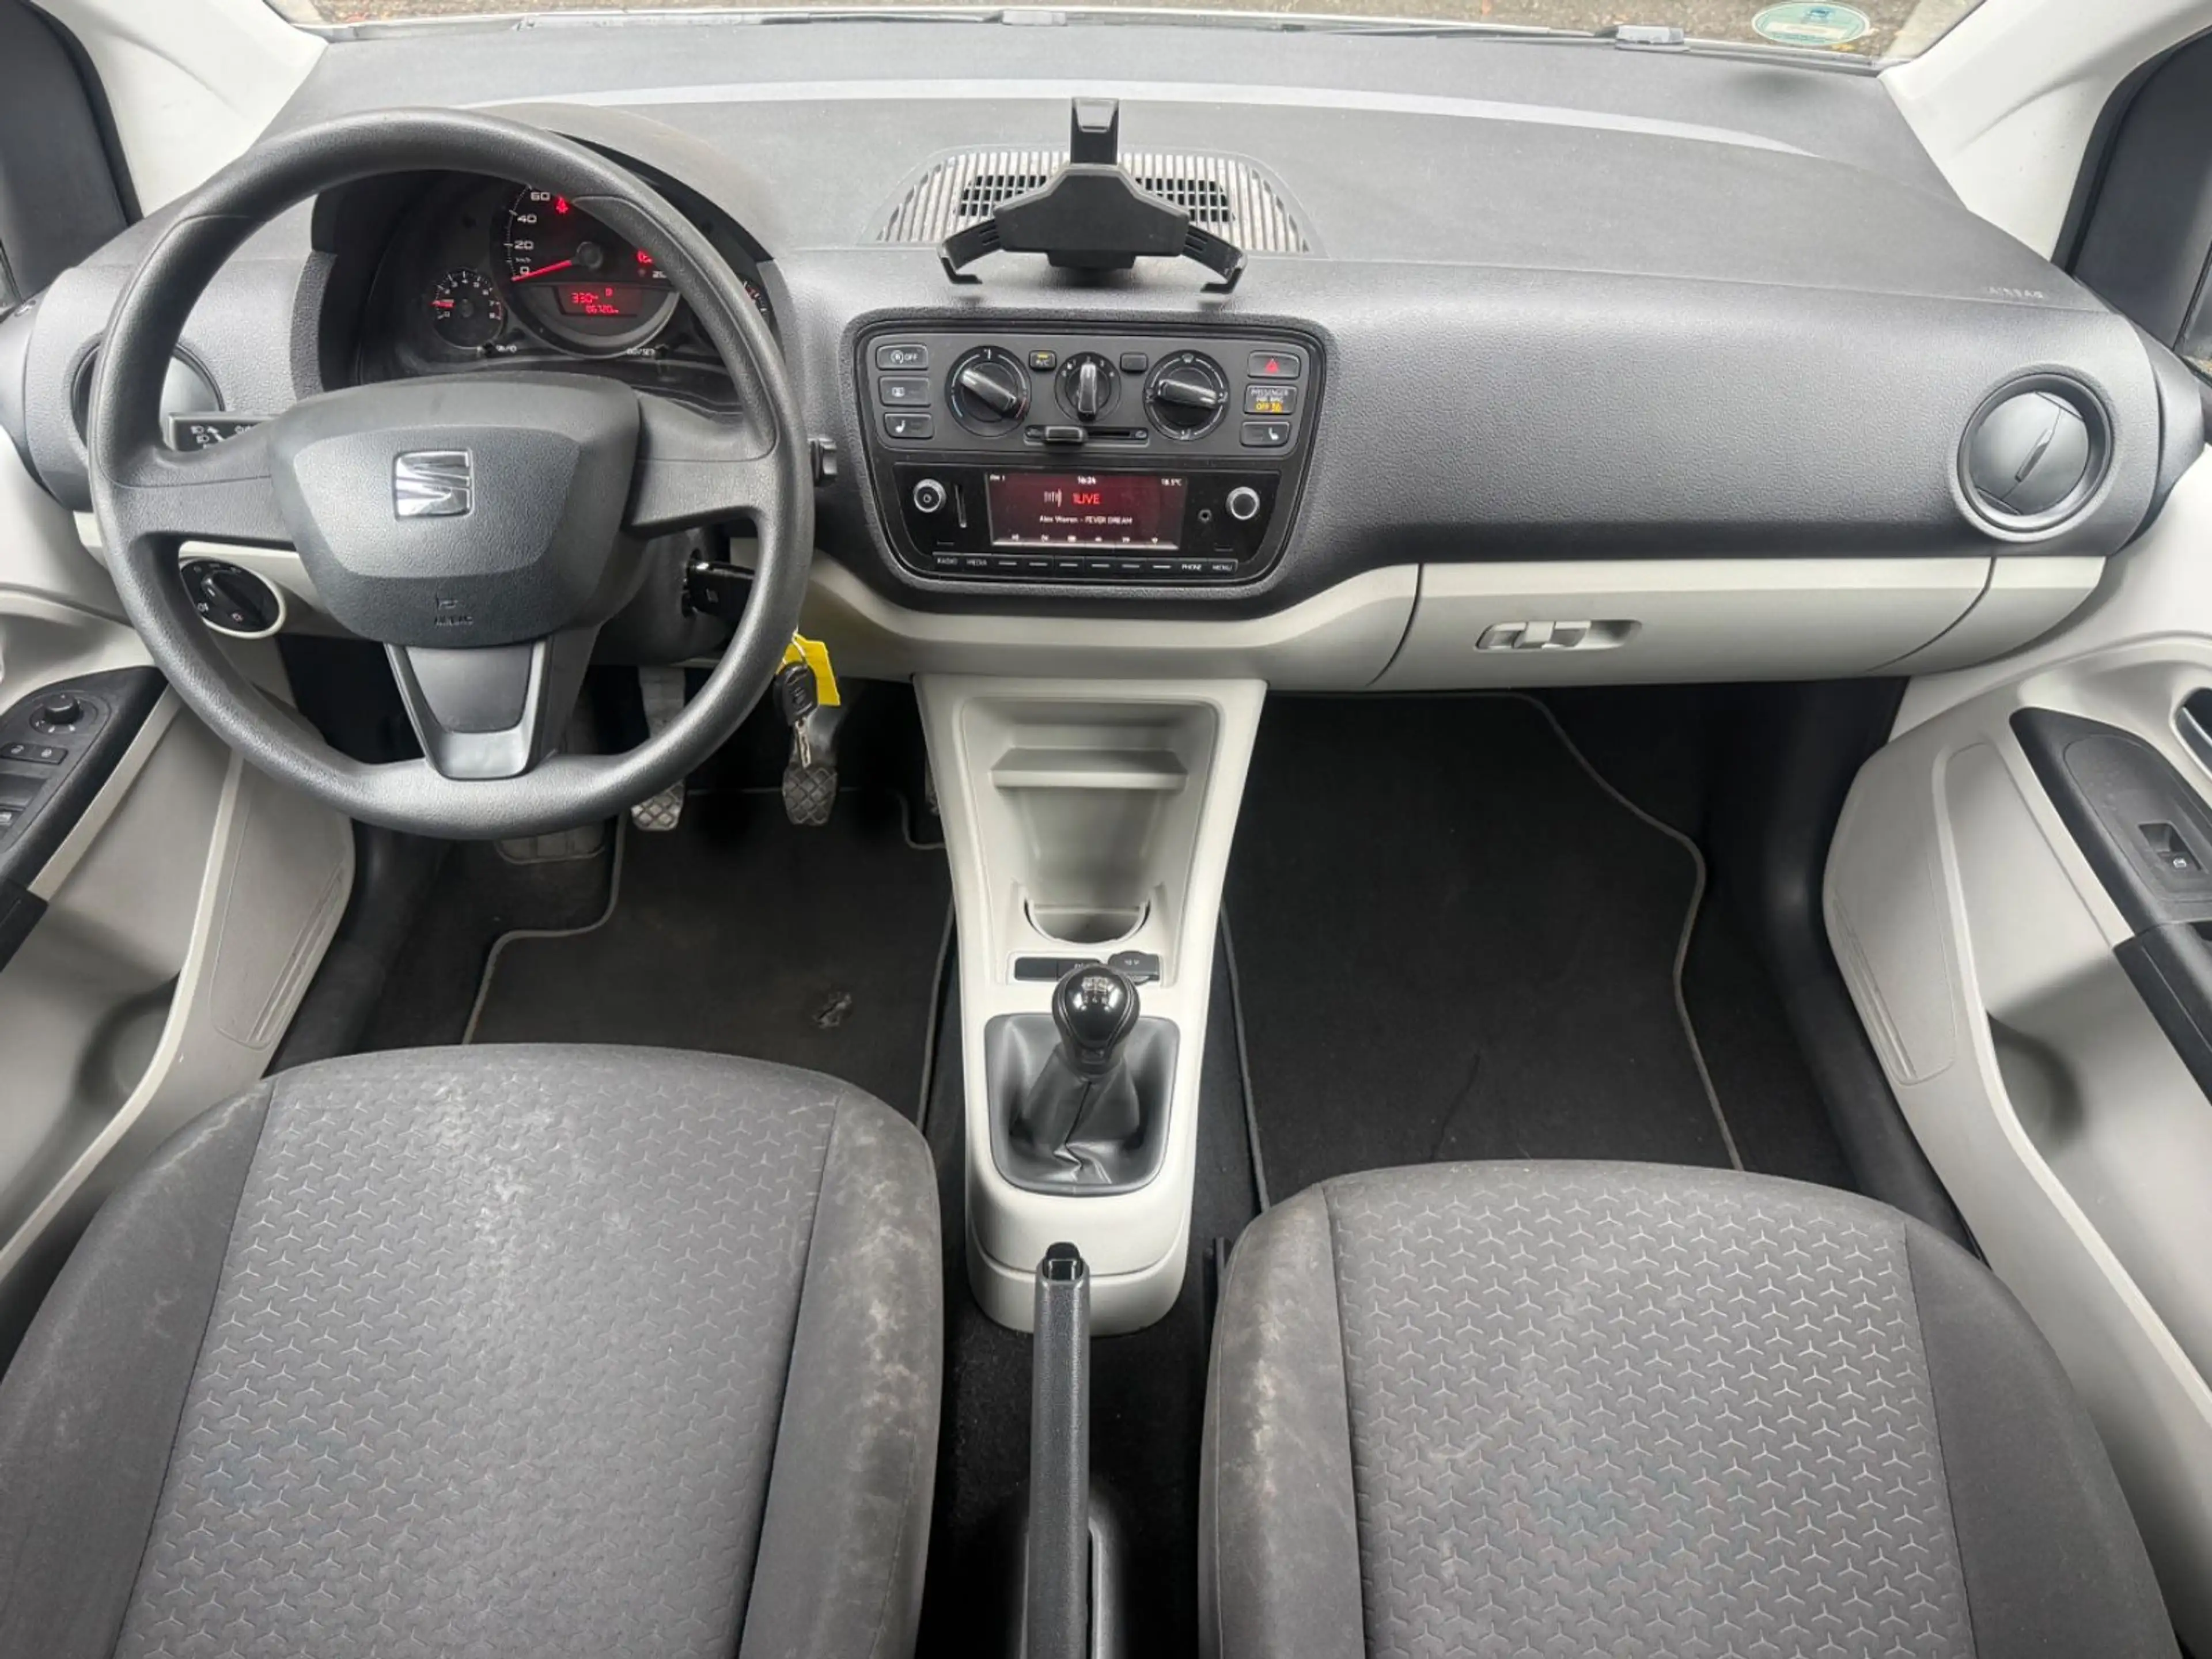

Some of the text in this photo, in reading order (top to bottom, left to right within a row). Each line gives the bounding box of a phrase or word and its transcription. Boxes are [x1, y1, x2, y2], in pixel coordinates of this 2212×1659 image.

[531, 191, 550, 201] 60
[517, 214, 537, 224] 40
[514, 240, 534, 250] 20
[1073, 493, 1100, 505] 1LIVE
